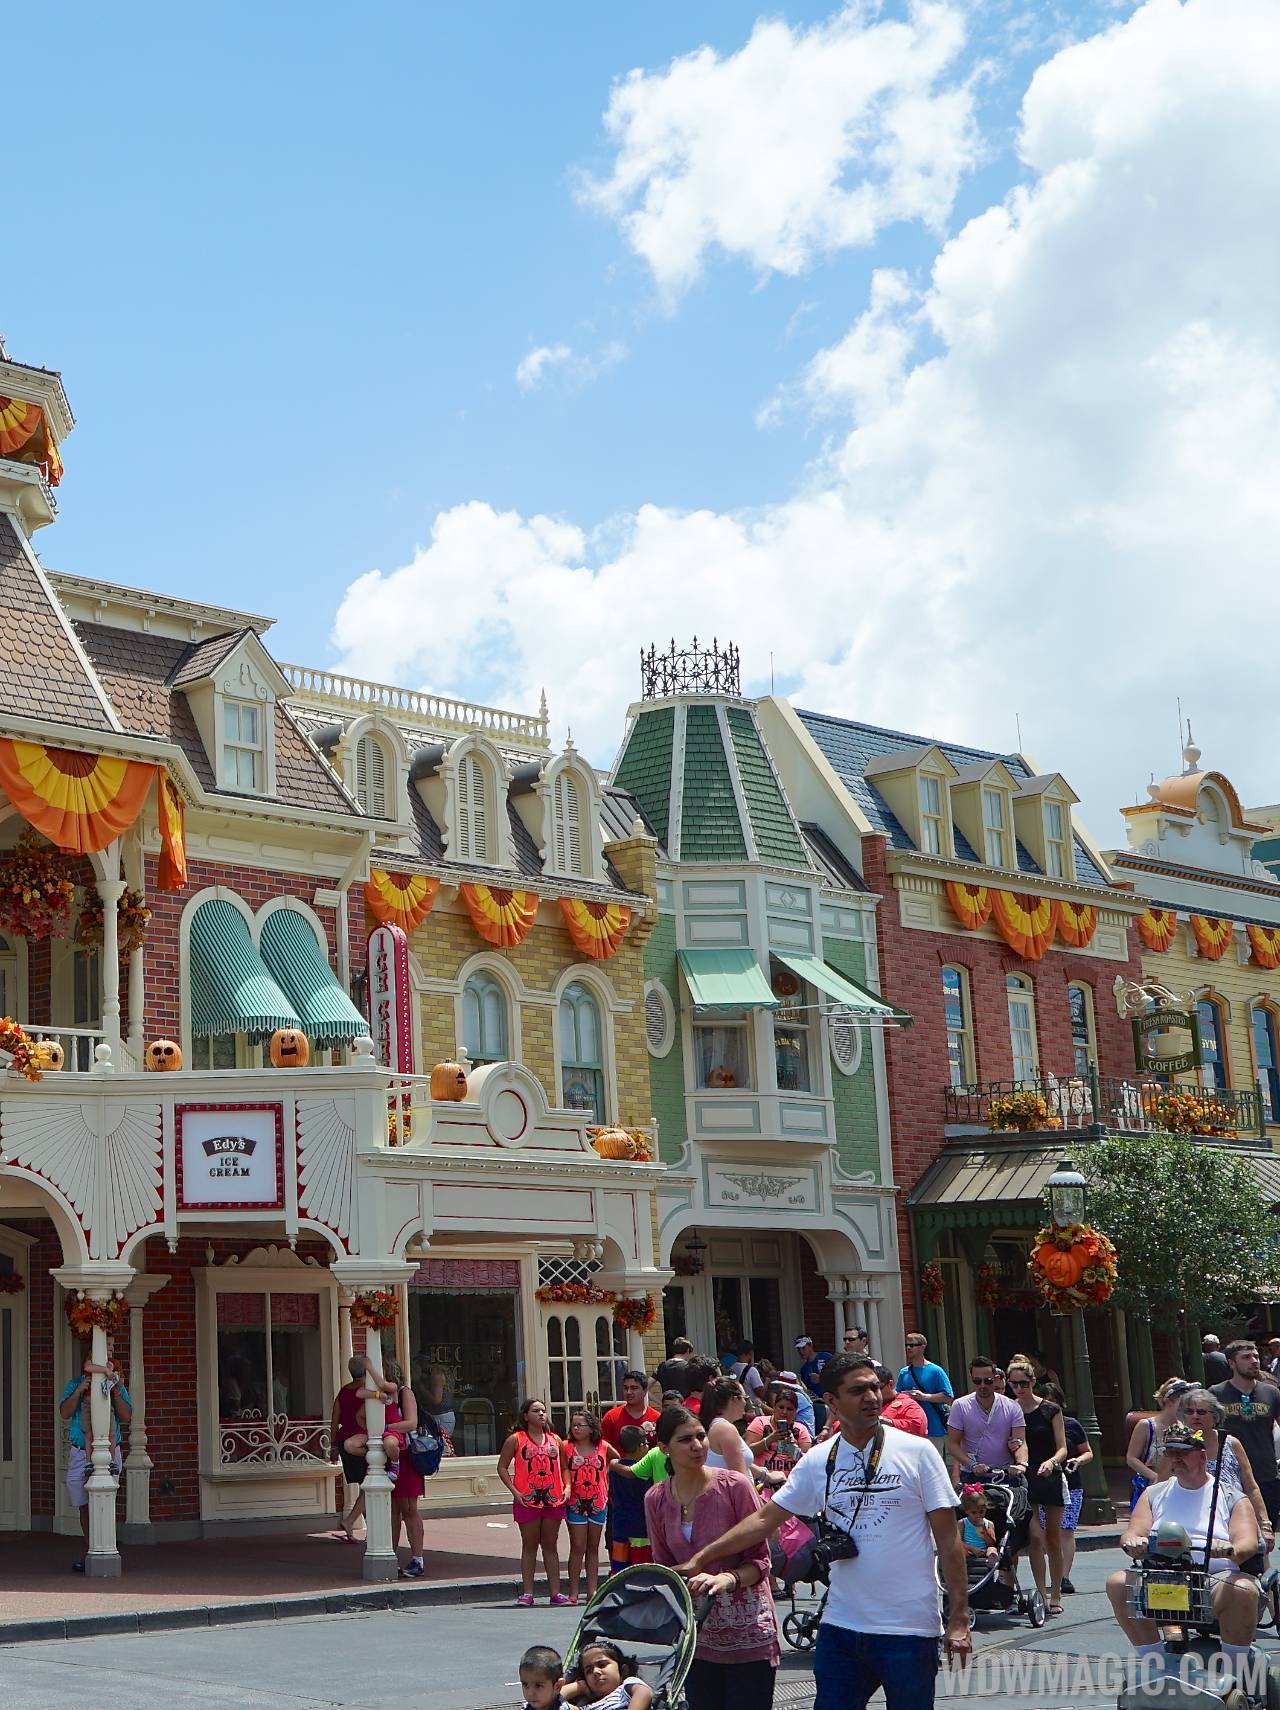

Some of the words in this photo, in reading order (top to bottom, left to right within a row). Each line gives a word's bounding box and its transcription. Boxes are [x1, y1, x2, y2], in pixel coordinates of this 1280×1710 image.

[1148, 1057, 1189, 1072] COFFEE
[212, 1139, 246, 1151] Edy's
[220, 1158, 239, 1166] ICE
[209, 1168, 250, 1177] CREAM
